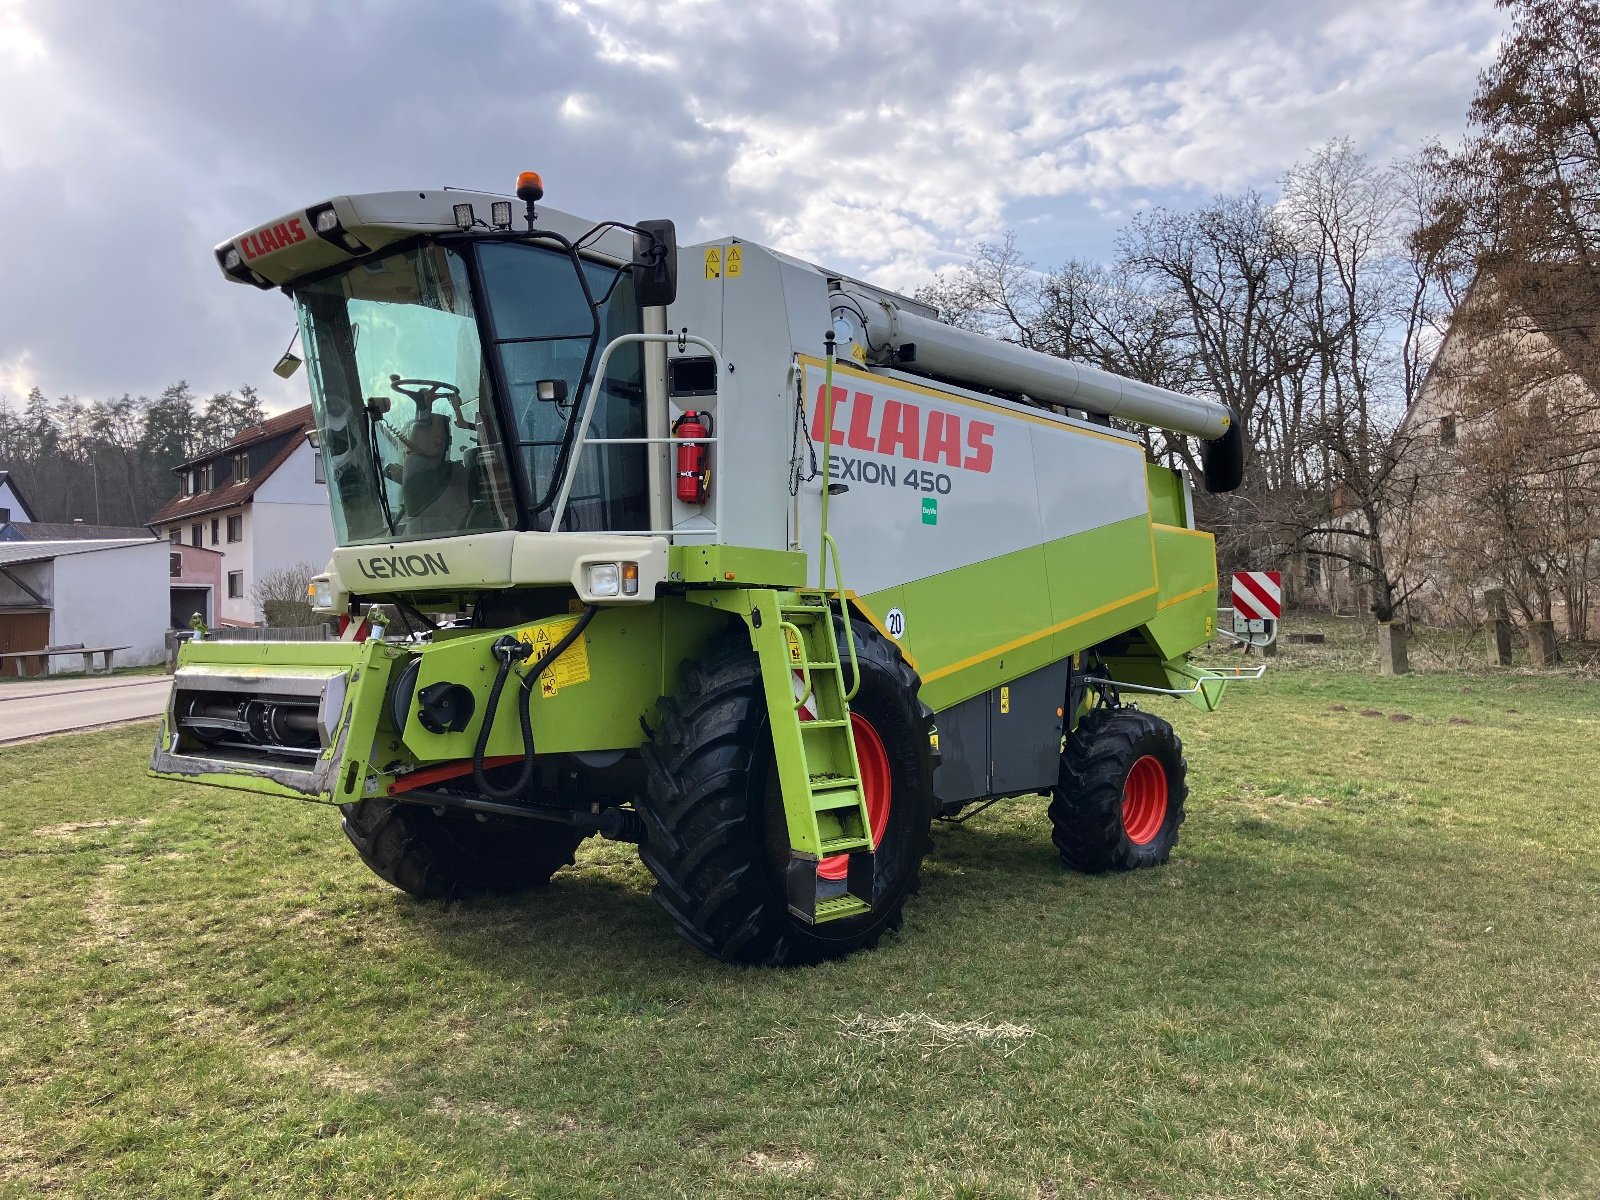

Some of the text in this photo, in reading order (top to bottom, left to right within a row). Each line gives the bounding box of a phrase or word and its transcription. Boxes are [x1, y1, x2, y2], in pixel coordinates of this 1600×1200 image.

[240, 218, 307, 260] CLAAS
[811, 384, 995, 473] CLAAS
[903, 469, 951, 494] 450
[357, 553, 450, 578] LEXION
[890, 613, 901, 634] 20
